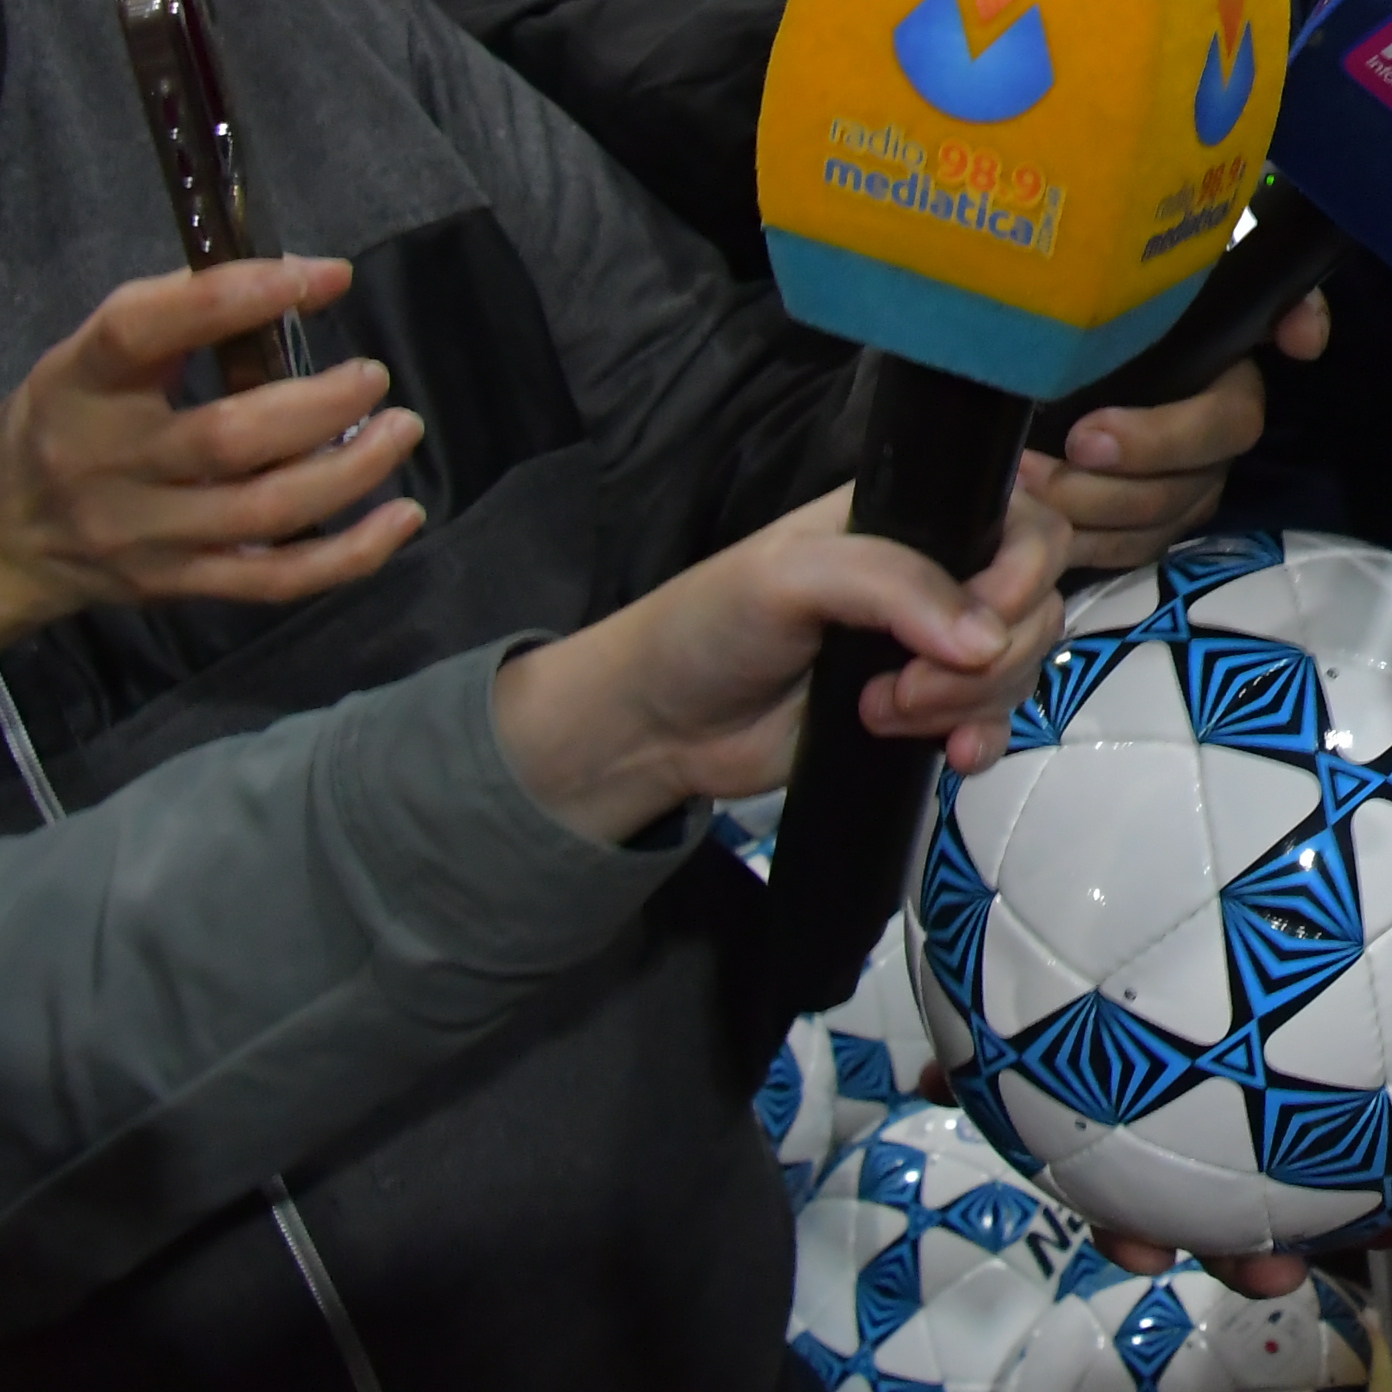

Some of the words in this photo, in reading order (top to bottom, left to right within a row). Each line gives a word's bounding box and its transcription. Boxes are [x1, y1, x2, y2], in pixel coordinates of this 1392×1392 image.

[824, 157, 1036, 248] mediatica
[829, 118, 926, 171] radio
[938, 140, 1045, 207] 98.9
